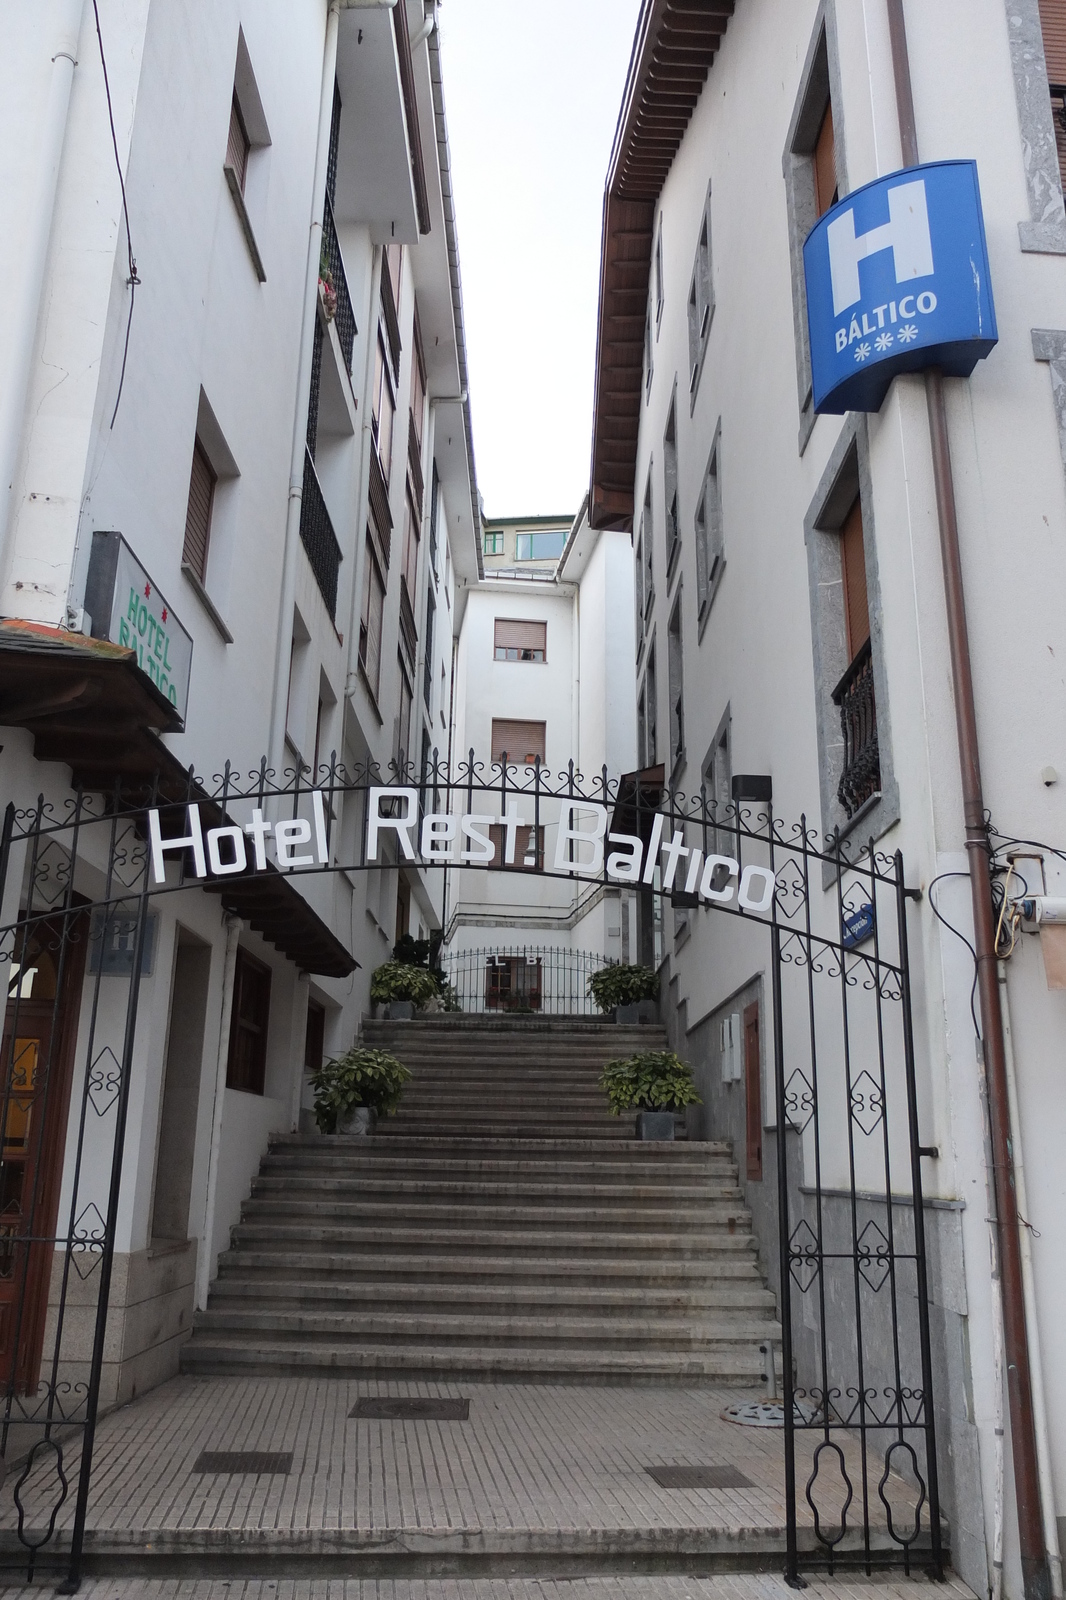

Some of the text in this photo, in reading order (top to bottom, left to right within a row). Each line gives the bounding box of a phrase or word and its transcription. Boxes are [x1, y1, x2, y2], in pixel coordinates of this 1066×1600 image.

[826, 179, 934, 318] H
[834, 291, 938, 353] BÁLTICO
[127, 587, 172, 671] HOTEL
[149, 787, 776, 912] Hotel Rest. Baltico
